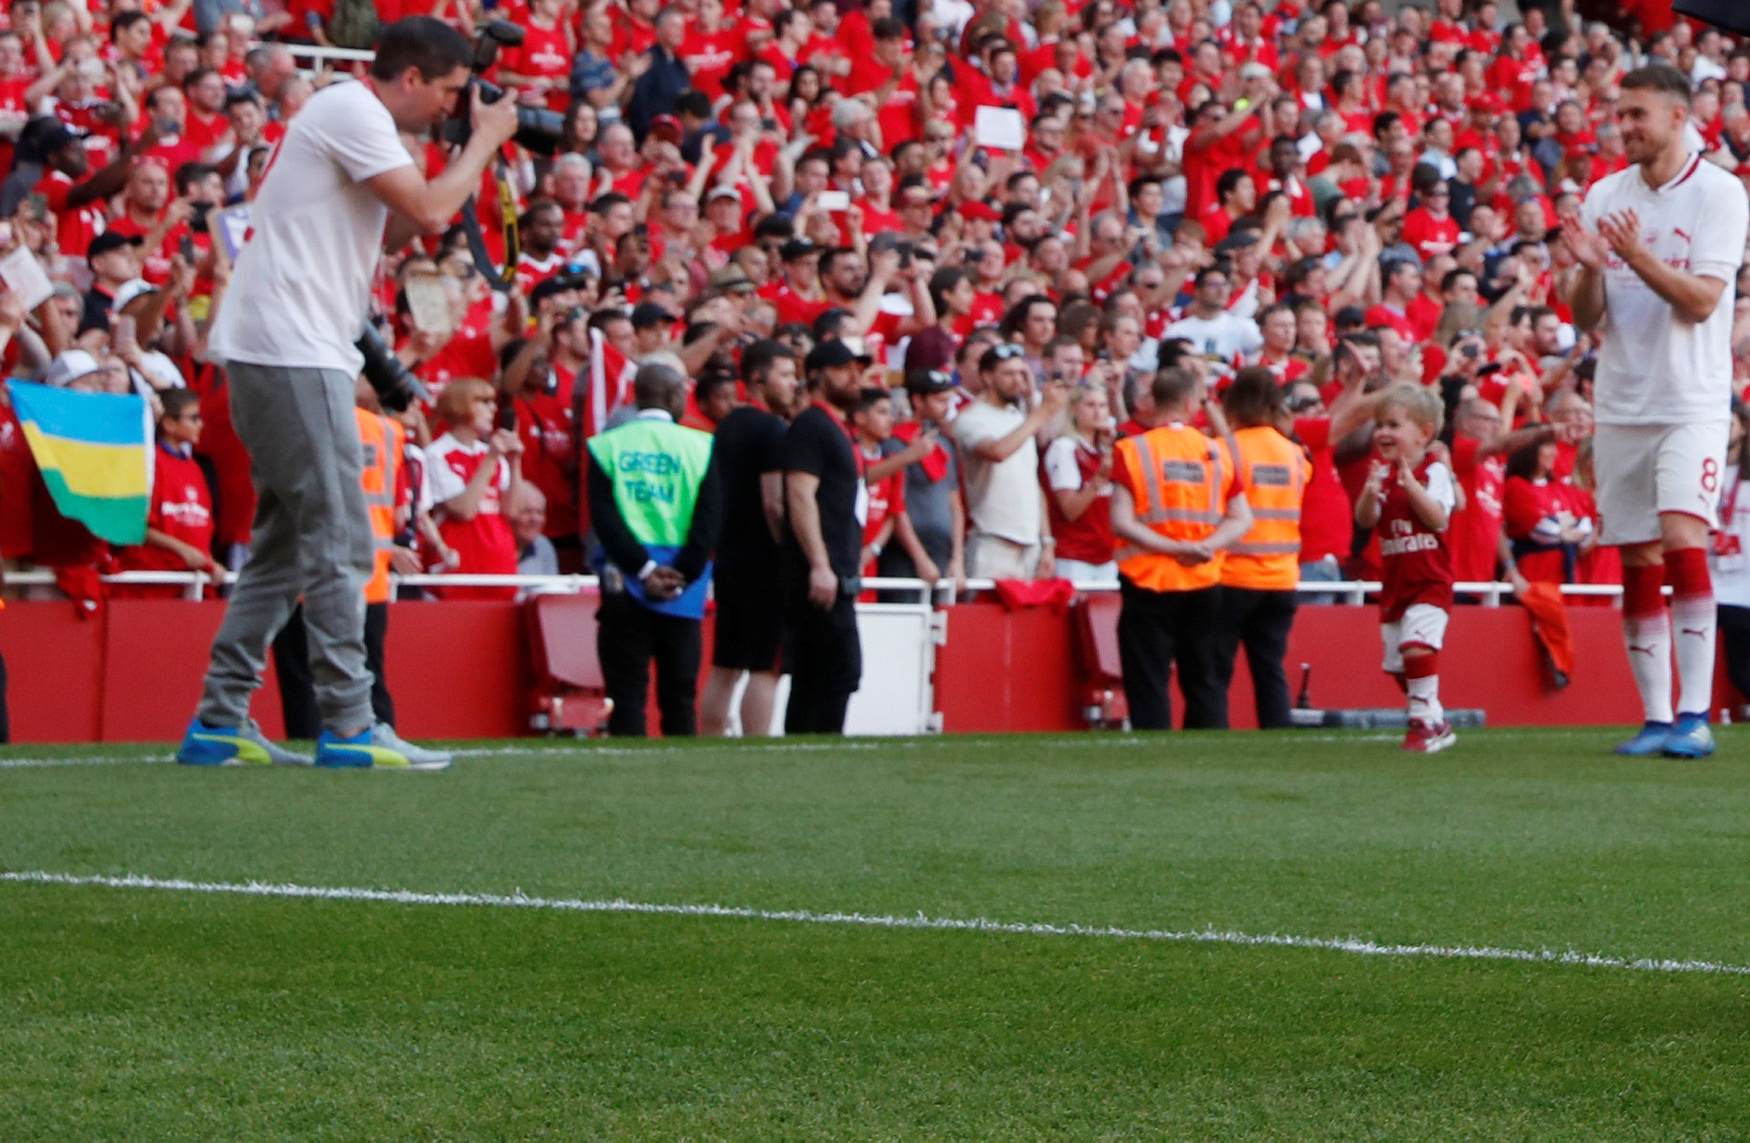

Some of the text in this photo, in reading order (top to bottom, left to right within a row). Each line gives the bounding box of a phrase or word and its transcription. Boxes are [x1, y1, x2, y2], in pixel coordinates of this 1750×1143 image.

[618, 451, 682, 475] GREEN
[1701, 457, 1718, 493] 8
[624, 479, 675, 504] TEAM
